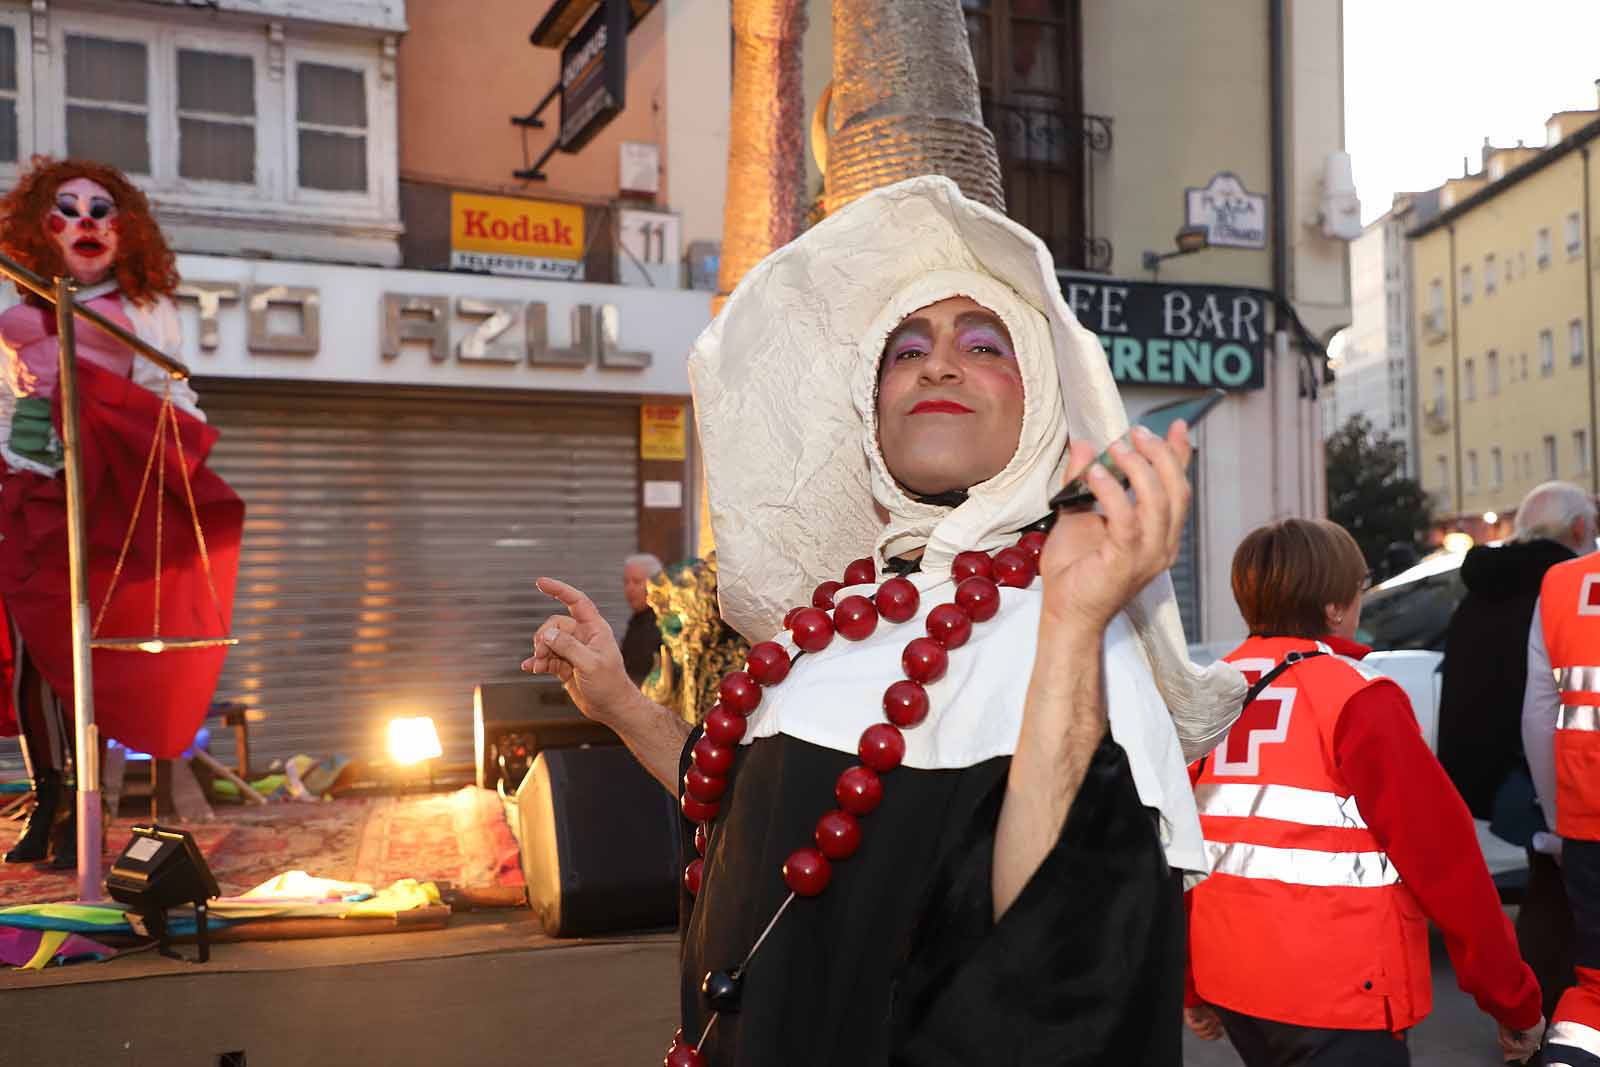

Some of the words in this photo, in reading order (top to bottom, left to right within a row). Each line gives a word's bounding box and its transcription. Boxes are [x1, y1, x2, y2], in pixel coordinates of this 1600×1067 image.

[463, 209, 573, 246] Kodak
[640, 220, 663, 264] 11
[176, 281, 320, 356] TO
[381, 292, 652, 369] AZUL
[1164, 291, 1259, 343] BAR
